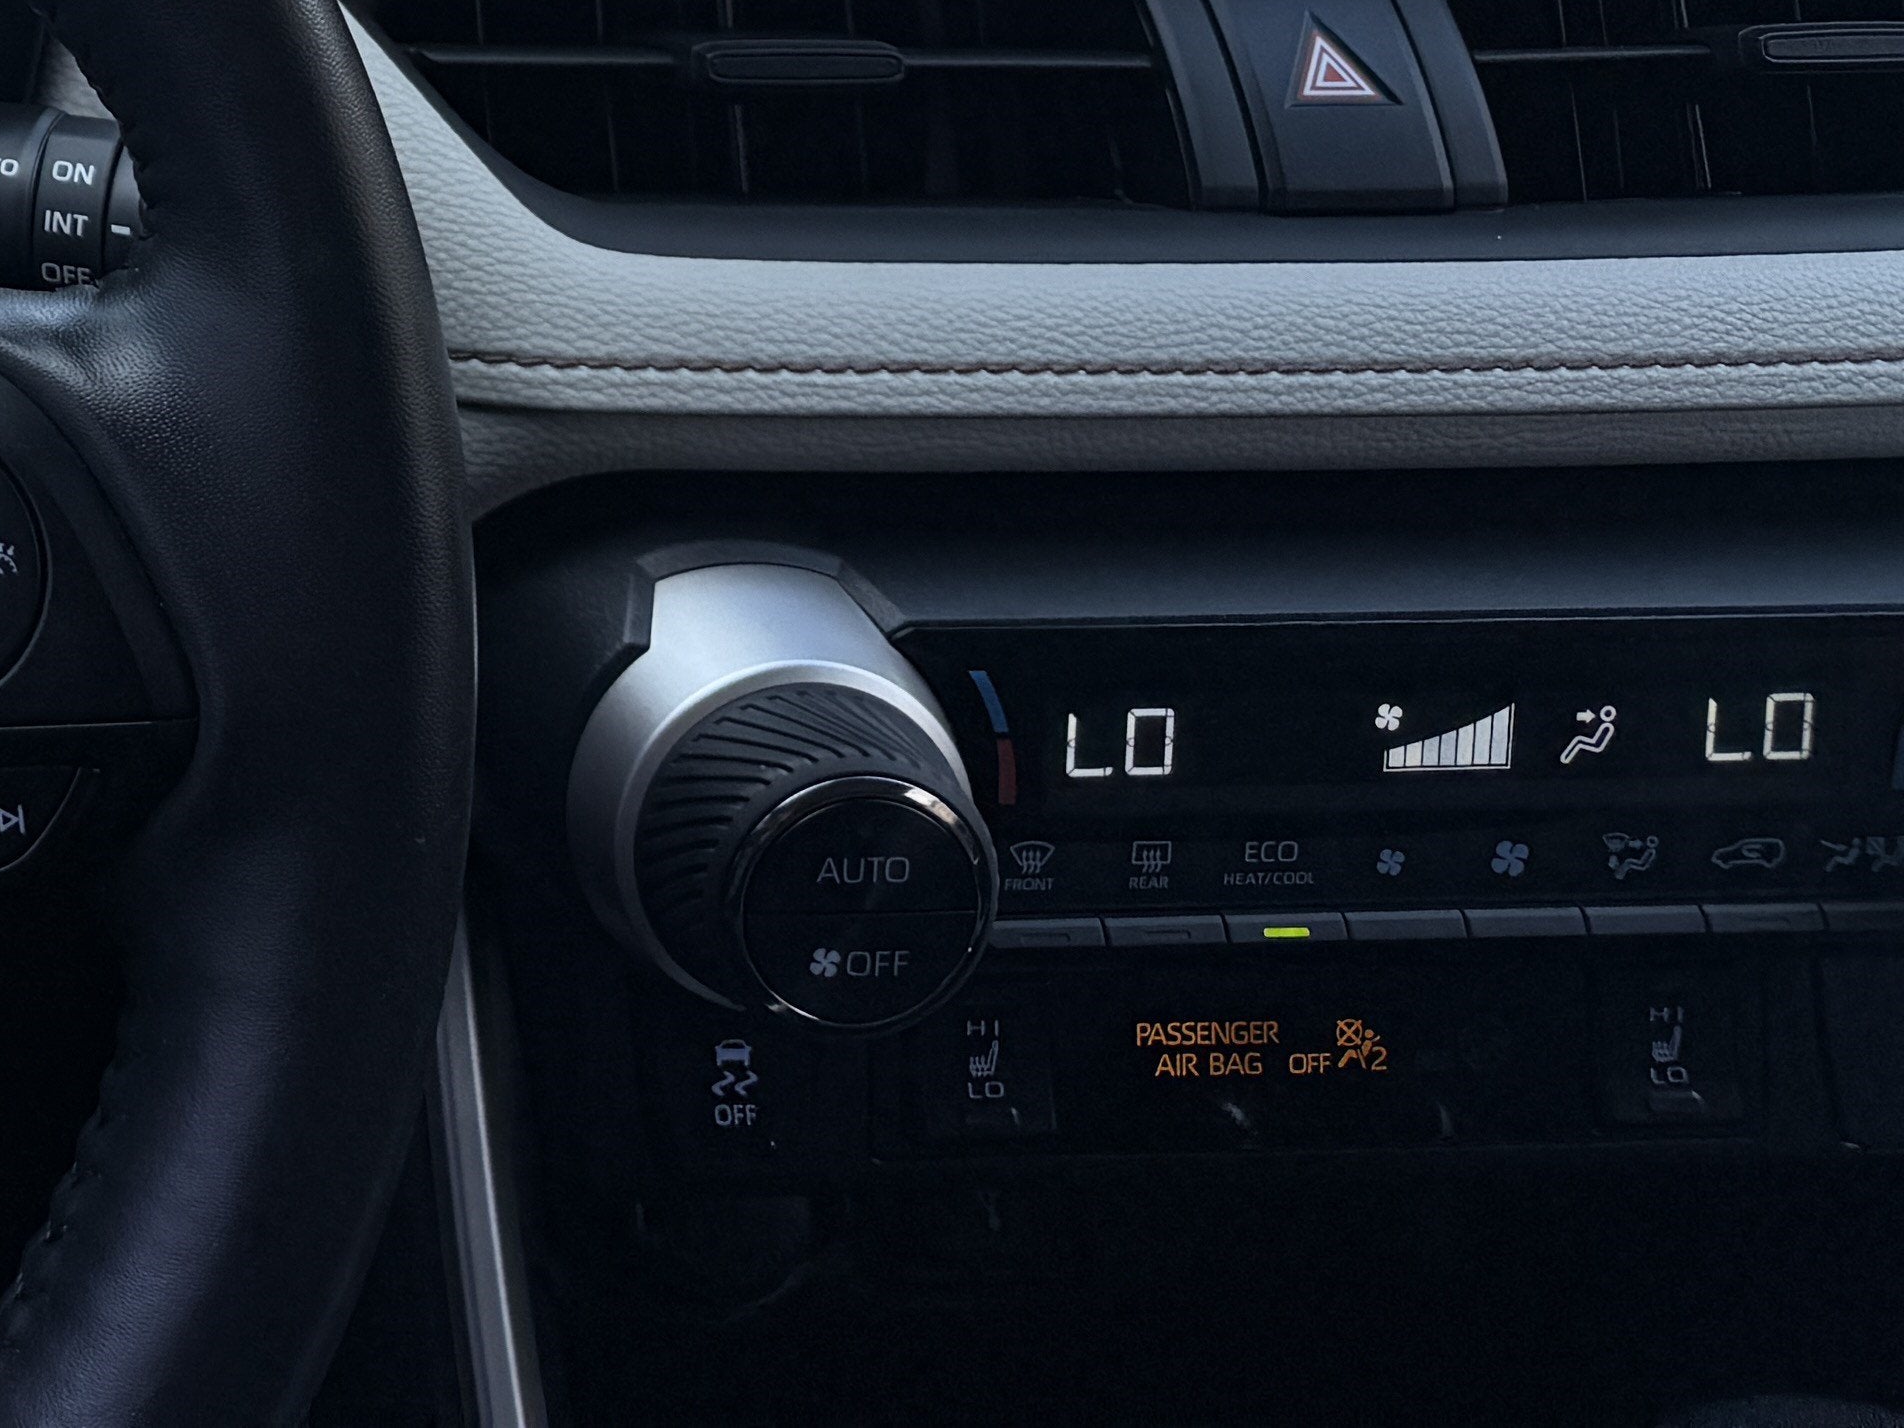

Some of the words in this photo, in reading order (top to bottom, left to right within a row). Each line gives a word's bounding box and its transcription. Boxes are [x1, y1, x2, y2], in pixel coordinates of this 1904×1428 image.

[52, 160, 96, 186] ON
[44, 209, 89, 237] INT
[41, 262, 92, 286] OFF
[1244, 840, 1299, 863] ECO
[816, 855, 911, 884] AUTO
[1223, 871, 1315, 886] HEAT/COOL
[1003, 876, 1055, 892] FRONT
[1128, 874, 1169, 890] REAR
[846, 950, 909, 977] OFF
[1649, 1006, 1684, 1023] HI
[966, 1019, 1000, 1037] HI
[1136, 1021, 1279, 1047] PASSENGER
[1154, 1053, 1200, 1077] AIR
[1209, 1052, 1263, 1076] BAG
[1288, 1052, 1331, 1075] OFF
[1649, 1066, 1689, 1085] LO
[967, 1081, 1005, 1099] LO
[714, 1103, 757, 1127] OFF
